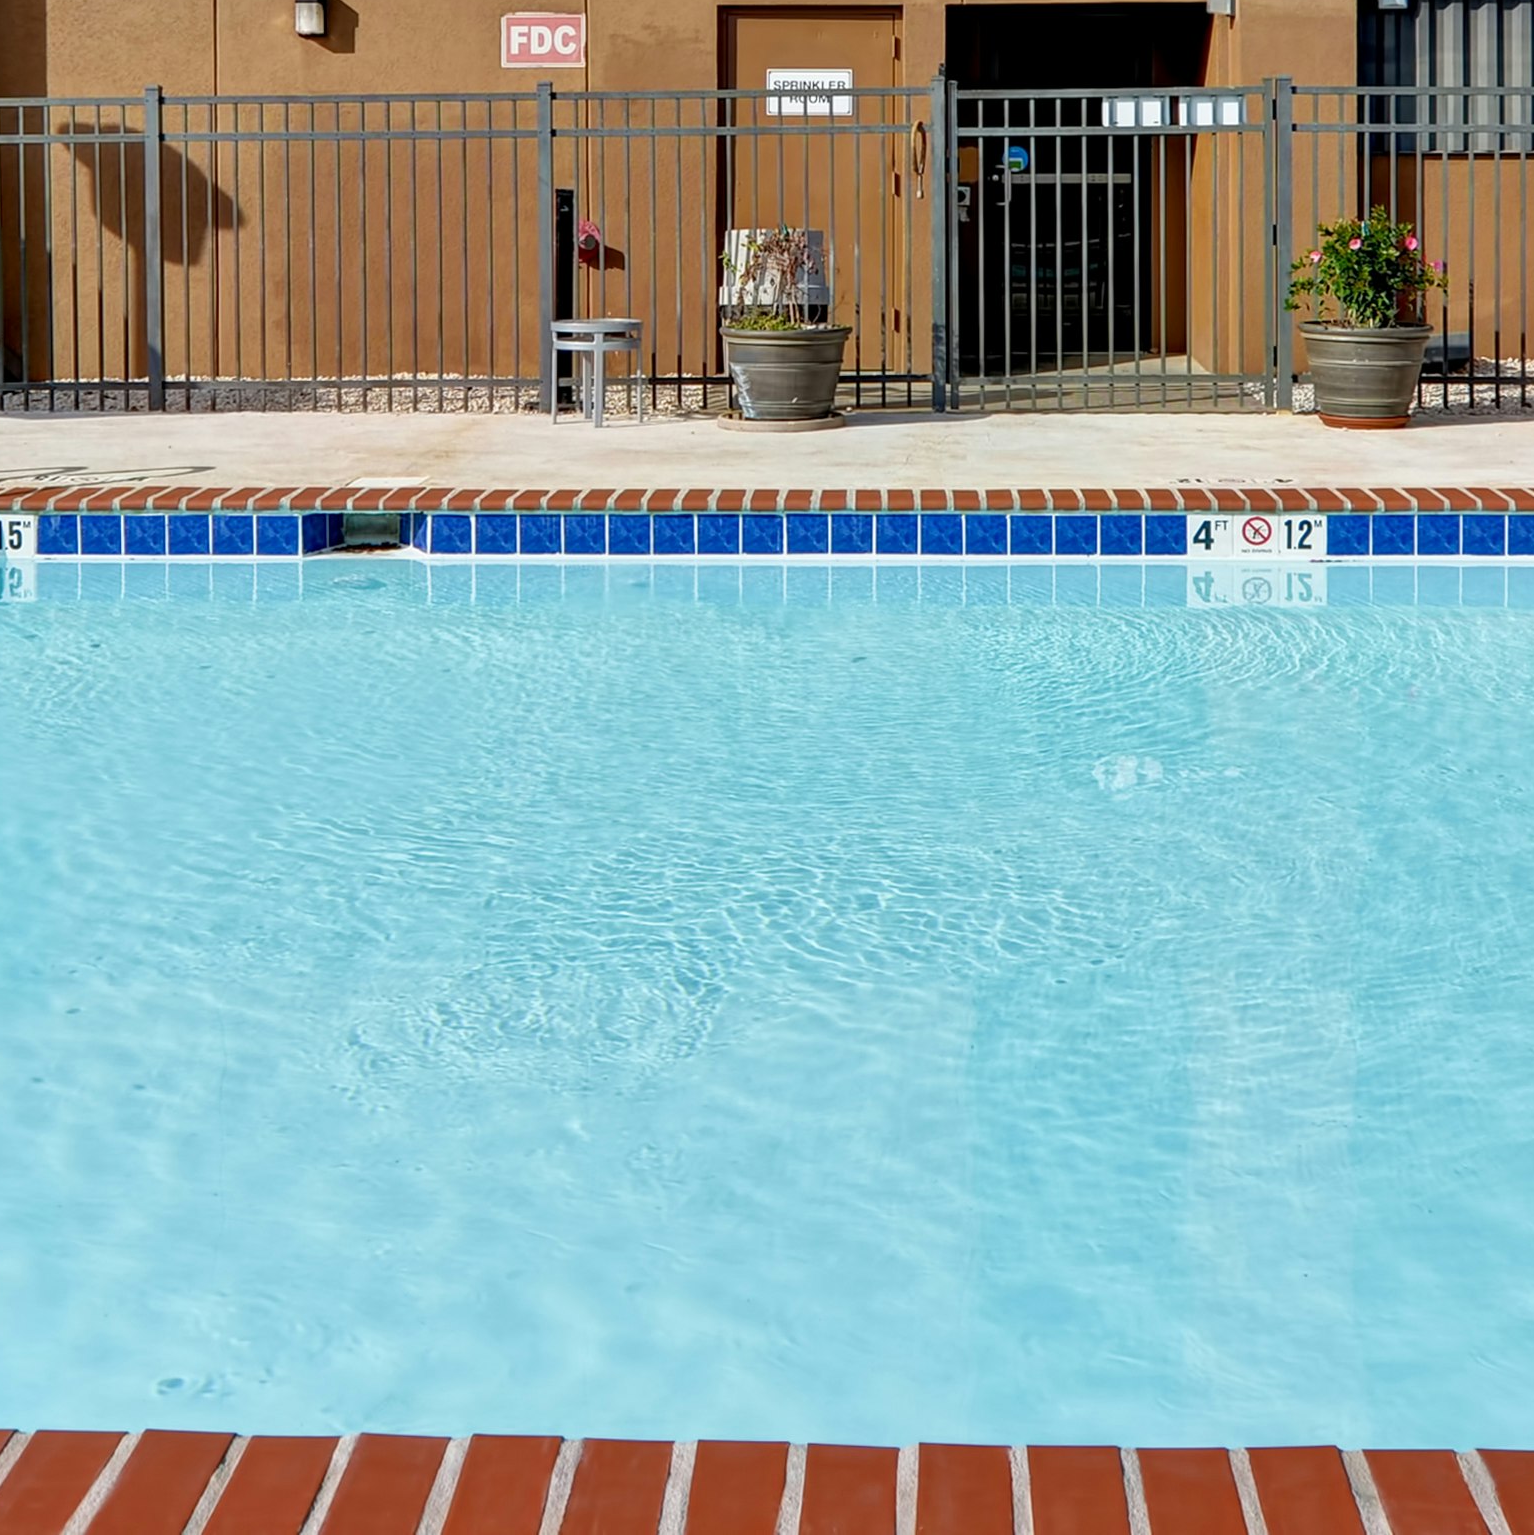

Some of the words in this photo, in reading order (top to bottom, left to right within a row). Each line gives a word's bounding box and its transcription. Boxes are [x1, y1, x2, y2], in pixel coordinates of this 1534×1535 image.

[510, 25, 577, 55] FDC
[773, 80, 846, 92] SPRINKLER
[1192, 520, 1214, 550] 4
[1215, 520, 1229, 531] FT
